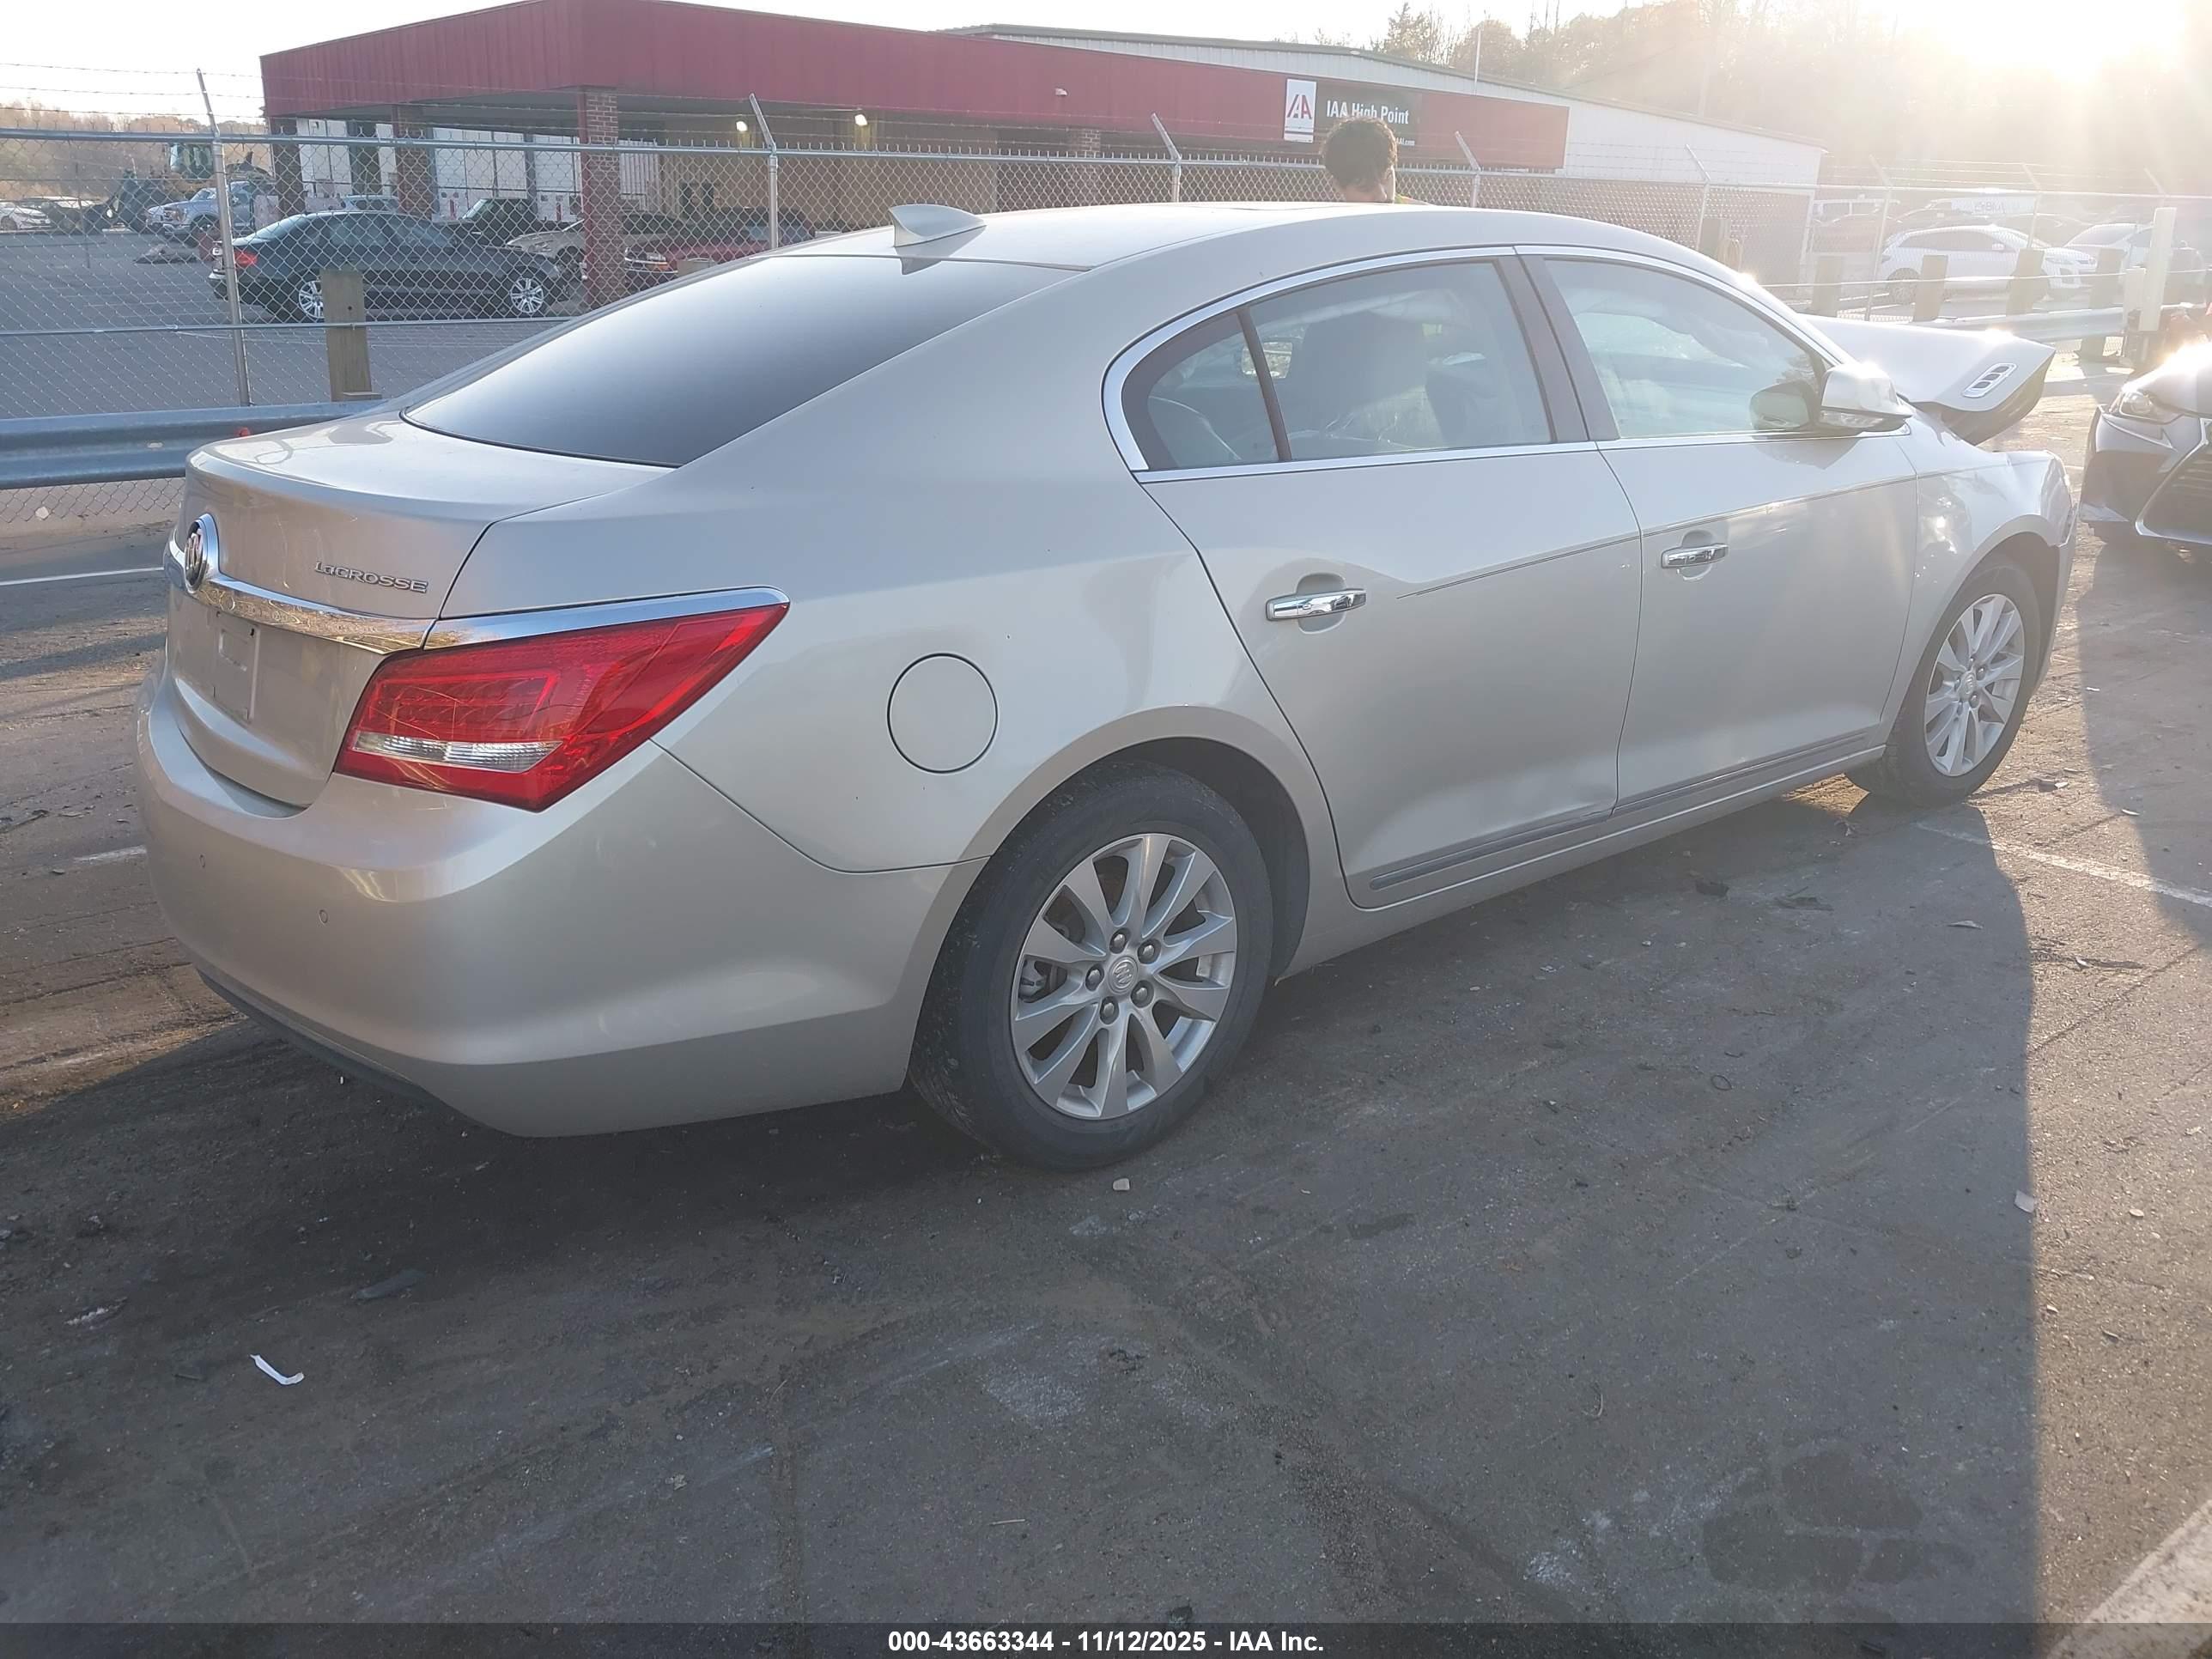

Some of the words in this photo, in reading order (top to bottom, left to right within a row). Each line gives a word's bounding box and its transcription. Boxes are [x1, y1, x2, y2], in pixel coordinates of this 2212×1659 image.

[1327, 100, 1348, 118] IAA
[1352, 102, 1377, 118] High
[1381, 106, 1409, 124] Point
[314, 561, 428, 593] LaCROSSE
